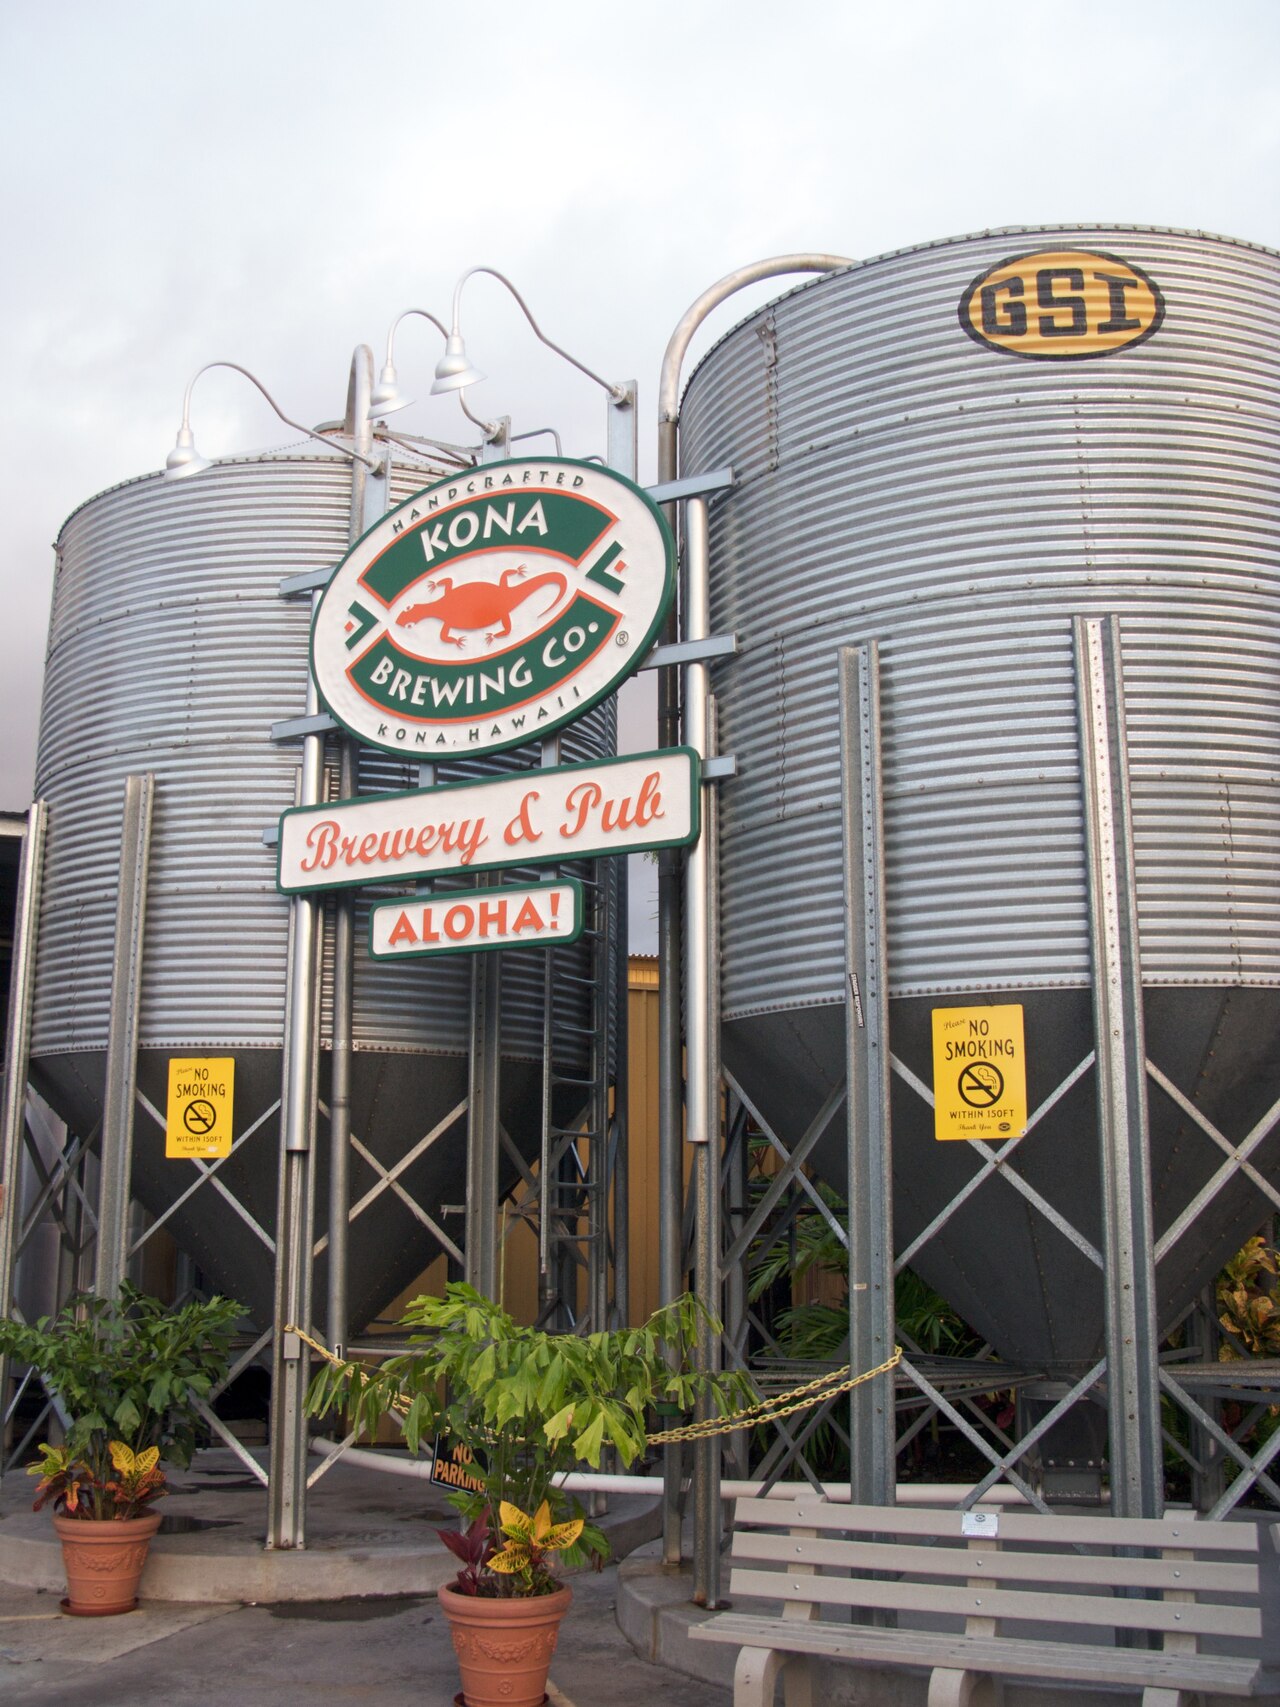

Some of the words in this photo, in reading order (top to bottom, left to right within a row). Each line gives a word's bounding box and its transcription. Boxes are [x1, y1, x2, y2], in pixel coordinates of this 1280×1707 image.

[980, 268, 1141, 337] GSI
[392, 470, 585, 534] HANDCRAFTED
[420, 499, 548, 562] KONA
[369, 656, 533, 708] BREWING
[542, 621, 599, 668] CO.
[377, 722, 456, 745] KONA,
[469, 685, 581, 742] HAWAII
[300, 816, 488, 873] Brewery
[503, 790, 543, 846] &
[559, 771, 665, 839] Pub
[388, 892, 561, 947] ALOHA!
[943, 1018, 966, 1031] Please
[969, 1019, 989, 1037] NO
[945, 1039, 1015, 1061] SMOKING
[176, 1083, 226, 1098] SMOKING
[194, 1068, 209, 1081] NO
[949, 1110, 984, 1119] WITHIN
[987, 1109, 1015, 1118] 150FT
